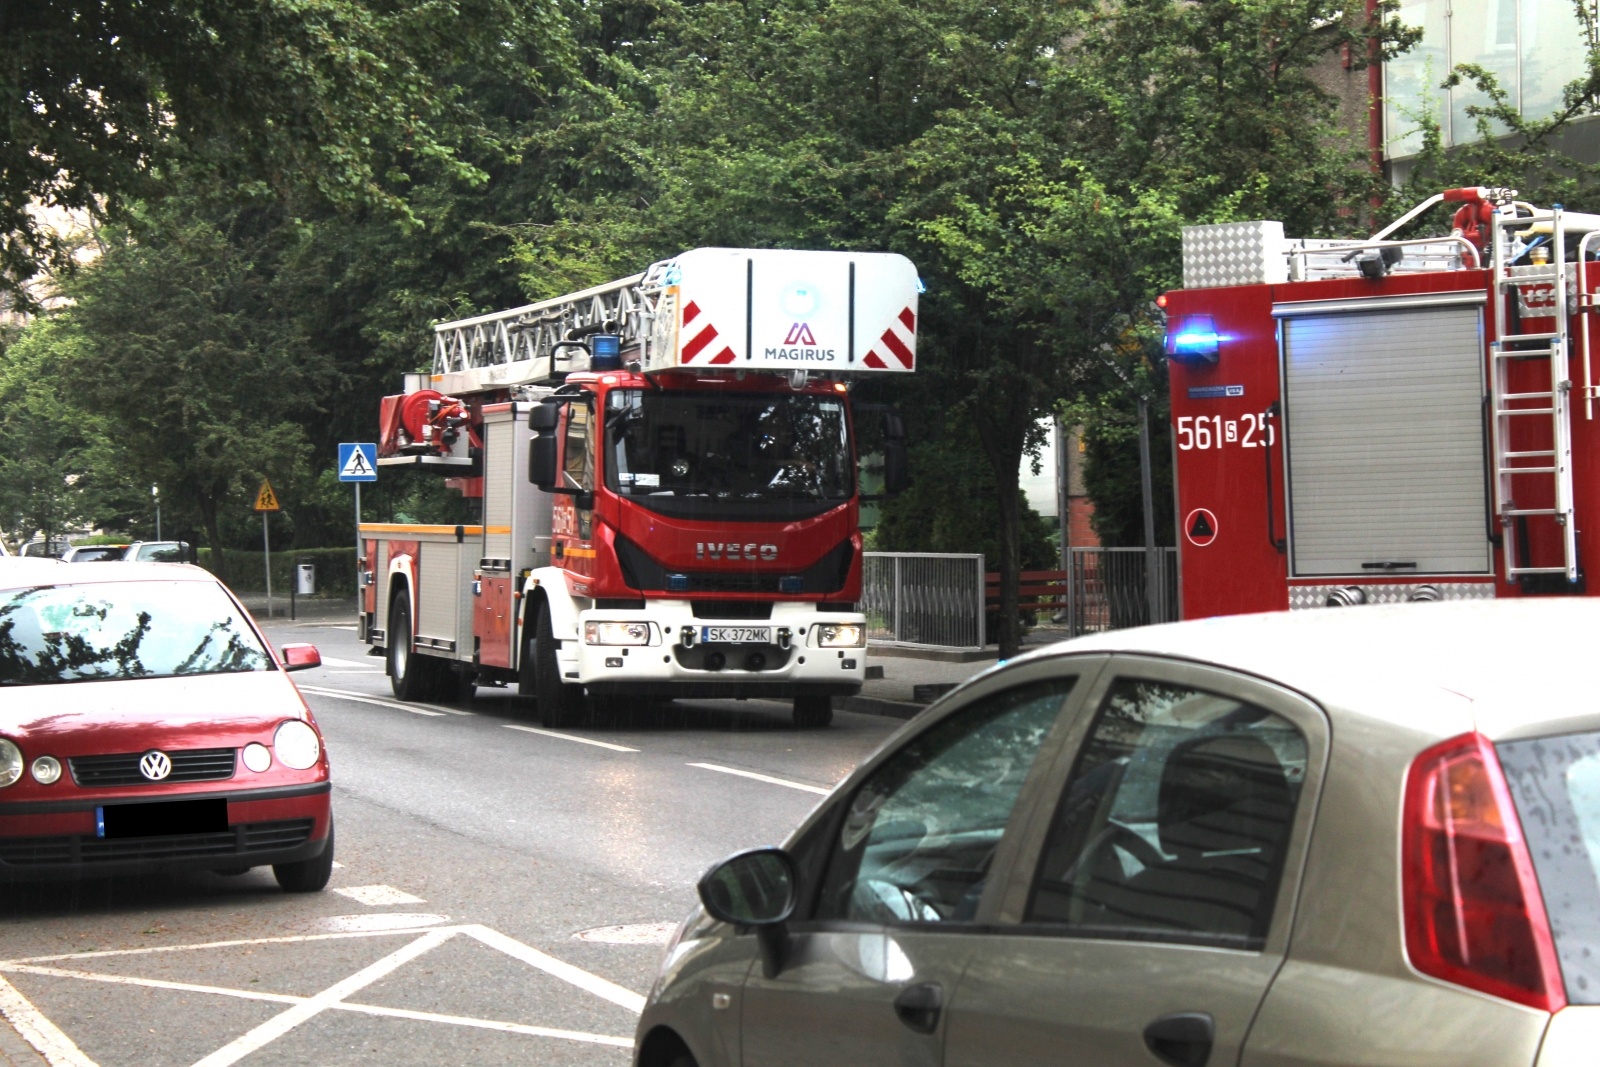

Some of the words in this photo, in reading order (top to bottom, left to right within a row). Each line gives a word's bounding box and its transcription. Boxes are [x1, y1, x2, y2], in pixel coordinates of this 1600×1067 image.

[765, 348, 835, 361] MAGIRUS
[696, 542, 778, 561] IVECO
[710, 628, 727, 641] SK
[731, 628, 768, 641] 372MK
